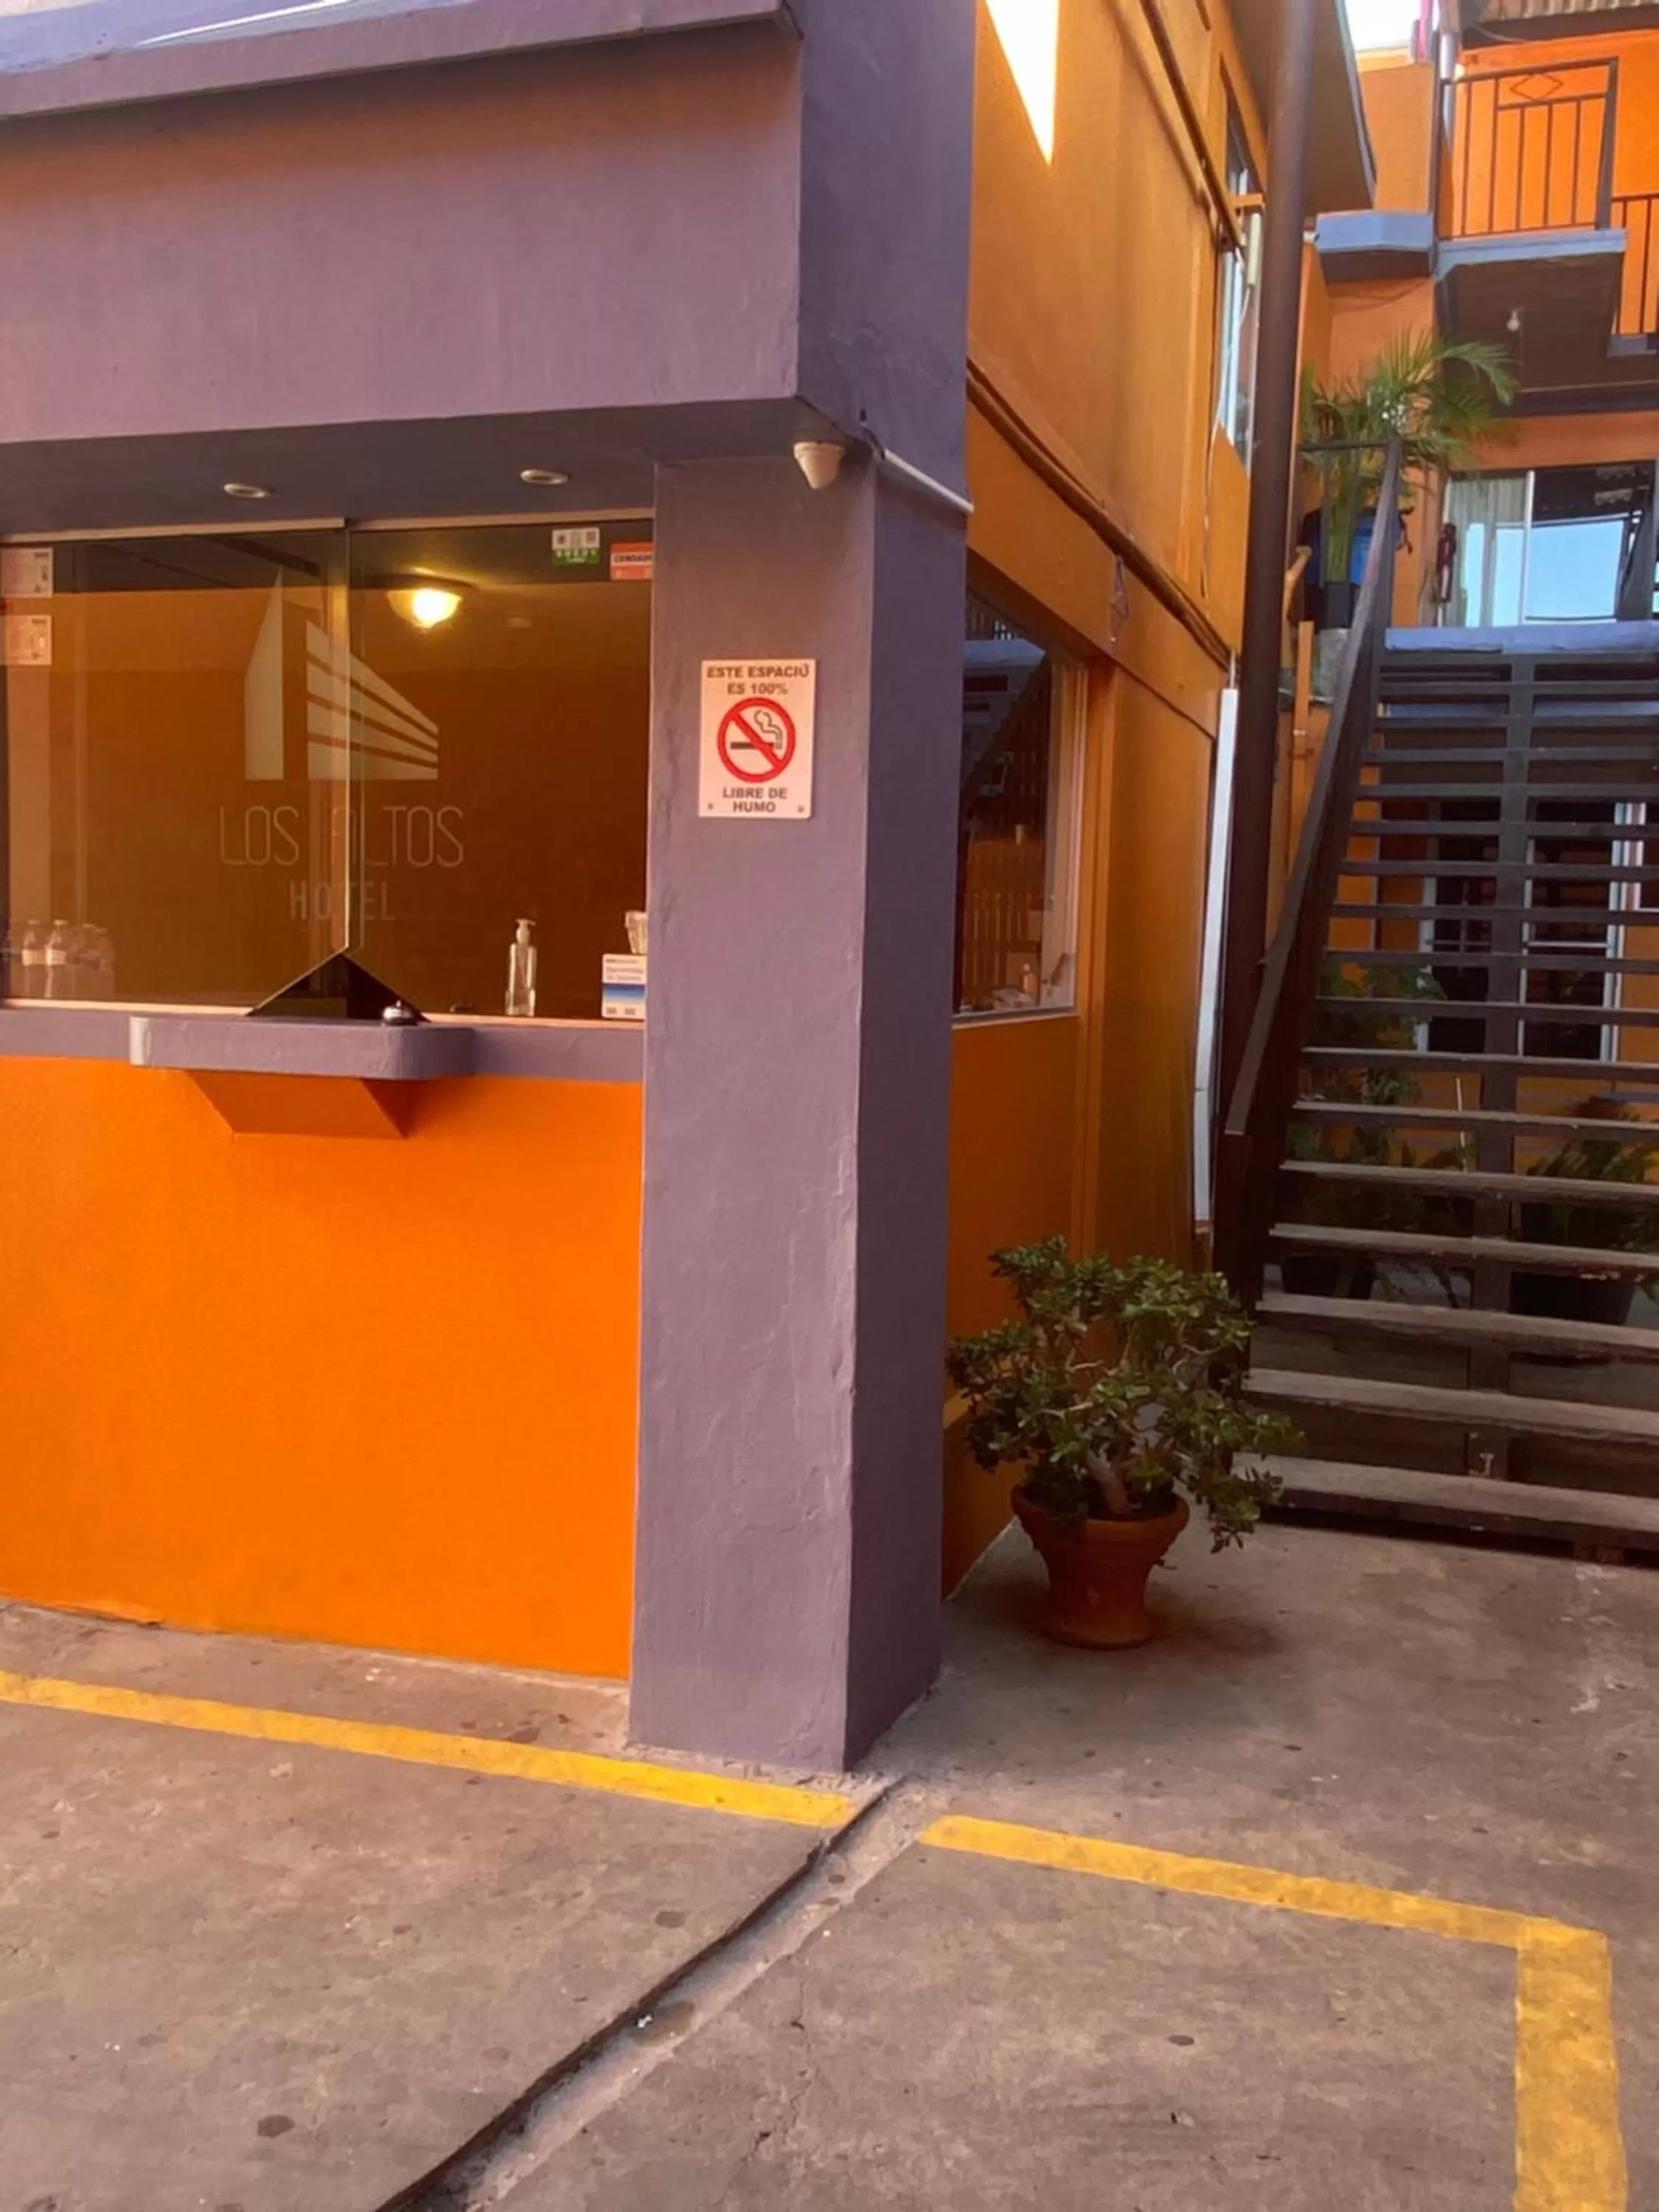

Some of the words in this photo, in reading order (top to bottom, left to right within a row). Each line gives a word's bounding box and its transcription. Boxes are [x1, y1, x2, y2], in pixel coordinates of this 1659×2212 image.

[707, 666, 743, 678] ESTE
[727, 684, 745, 695] ES
[751, 683, 788, 695] 100%
[723, 787, 764, 799] LIBRE
[768, 787, 787, 799] DE
[732, 801, 776, 813] HUMO
[219, 805, 300, 866] LOS
